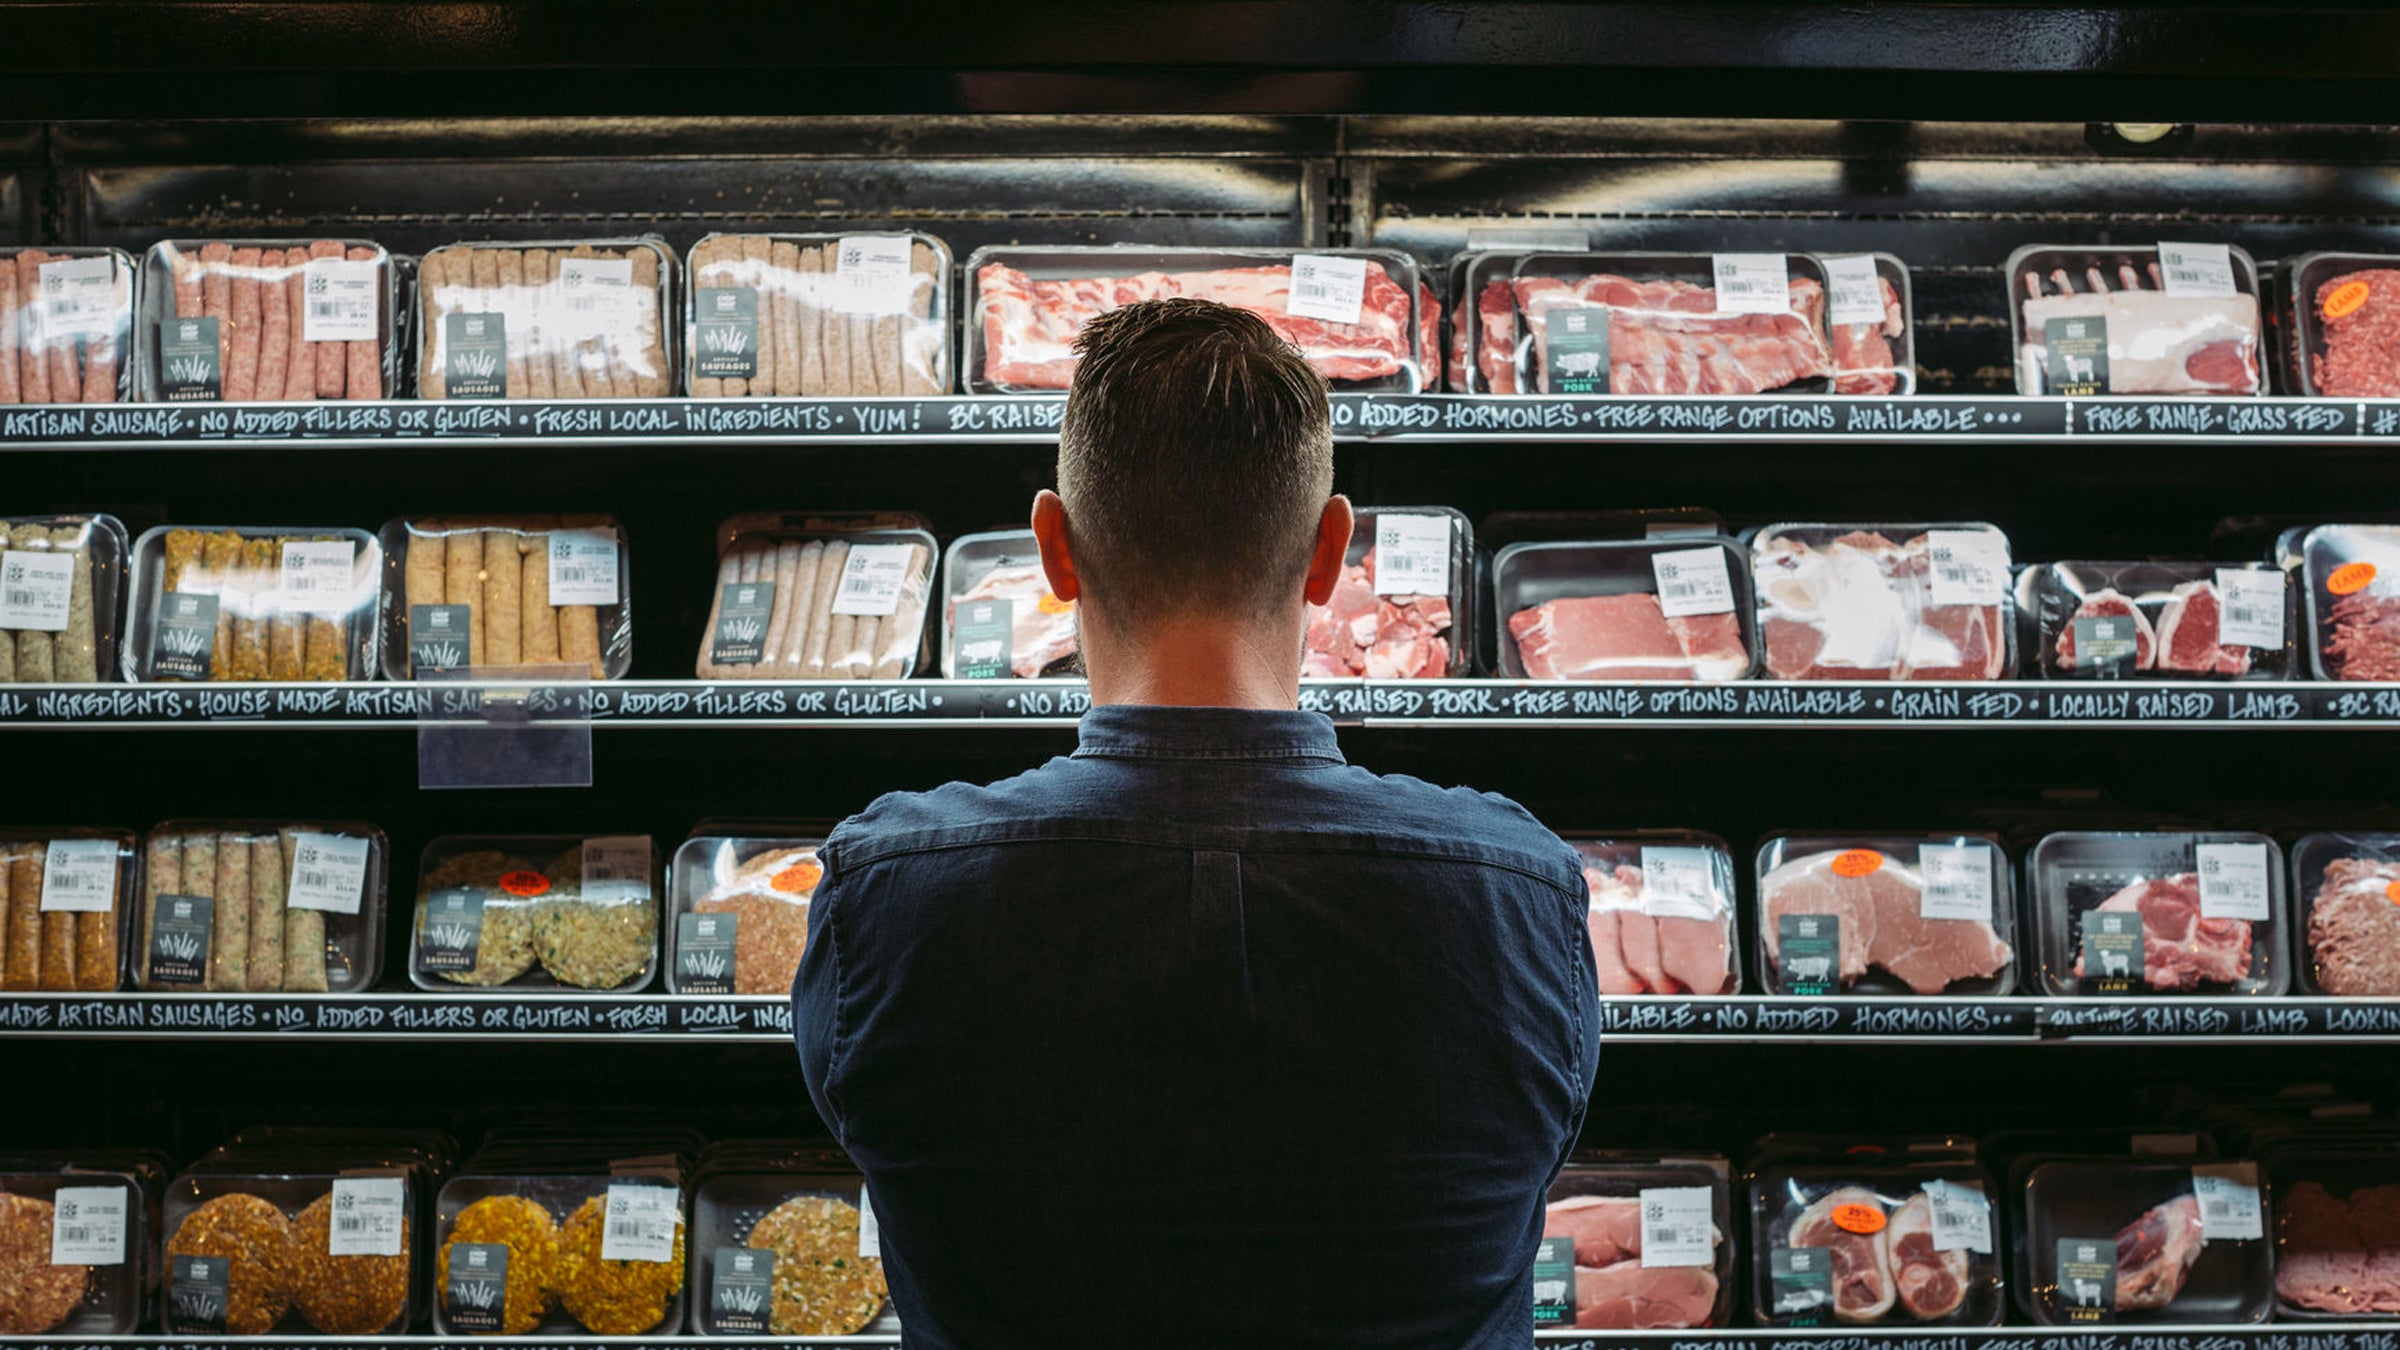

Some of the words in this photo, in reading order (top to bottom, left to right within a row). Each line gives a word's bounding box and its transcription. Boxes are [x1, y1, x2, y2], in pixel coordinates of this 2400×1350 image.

[2329, 285, 2364, 313] LAMB
[702, 362, 751, 371] SAUSAGES
[452, 386, 501, 394] SAUSAGES
[1563, 383, 1593, 392] PORK
[2064, 387, 2095, 396] LAMB
[169, 391, 216, 400] SAUSAGES
[4, 409, 86, 437] ARTISAN
[91, 408, 183, 437] SAUSAGE
[200, 410, 229, 432] NO
[234, 409, 300, 434] ADDED
[301, 406, 393, 432] FILLERS
[398, 408, 429, 430] OR
[434, 405, 512, 431] GLUTEN
[533, 405, 603, 435] FRESH
[610, 408, 680, 432] LOCAL
[685, 403, 832, 433] INGREDIENTS
[948, 404, 985, 432] BC
[986, 403, 1067, 430] RAISE
[1359, 402, 1440, 428] ADDED
[1443, 402, 1579, 430] HORMONES
[1593, 403, 1656, 429] FREE
[1658, 403, 1734, 431] RANGE
[1738, 403, 1836, 430] OPTIONS
[1847, 403, 1978, 432] AVAILABLE
[2084, 404, 2144, 432] FREE
[2147, 403, 2216, 431] RANGE
[2227, 404, 2287, 432] GRASS
[2288, 404, 2345, 431] FED
[2334, 567, 2371, 590] LAMB
[715, 648, 759, 659] SAUSAGES
[156, 660, 204, 673] SAUSAGES
[969, 667, 996, 679] PORK
[37, 689, 183, 720] INGREDIENTS
[200, 690, 271, 717] HOUSE
[277, 688, 340, 715] MADE
[346, 687, 433, 717] ARTISAN
[443, 689, 558, 714] SAUES
[578, 689, 610, 711] NO
[620, 689, 689, 715] ADDED
[692, 686, 787, 715] FILLERS
[796, 690, 826, 715] OR
[834, 687, 927, 715] GLUTEN
[1019, 690, 1053, 716] NO
[1299, 689, 1333, 714] BC
[1334, 685, 1424, 716] RAISED
[1428, 688, 1501, 716] PORK
[1512, 689, 1569, 716] FREE
[1573, 689, 1645, 718] RANGE
[1650, 687, 1740, 715] OPTIONS
[1745, 687, 1867, 716] AVAILABLE
[1890, 688, 1961, 720] GRAIN
[1966, 692, 2023, 719] FED
[2050, 691, 2131, 720] LOCALLY
[2135, 688, 2215, 719] RAISED
[2228, 691, 2301, 720] LAMB
[2339, 691, 2372, 716] BC
[426, 957, 471, 965] SAUSAGES
[154, 966, 200, 977] SAUSAGES
[681, 986, 729, 994] SAUSAGES
[1794, 987, 1823, 995] PORK
[2099, 982, 2129, 992] LAMB
[58, 1003, 145, 1028] ARTISAN
[150, 1003, 257, 1030] SAUSAGES
[275, 1006, 306, 1028] NO
[317, 1005, 385, 1028] ADDED
[389, 1005, 475, 1029] FILLERS
[482, 1006, 511, 1028] OR
[513, 1005, 591, 1029] GLUTEN
[607, 1004, 668, 1031] FRESH
[681, 1004, 748, 1027] LOCAL
[753, 1005, 793, 1031] ING
[1600, 1002, 1698, 1031] ILABLE
[1716, 1004, 1749, 1030] NO
[1755, 1004, 1840, 1032] ADDED
[1850, 1005, 1990, 1034] HORMONES
[2142, 1006, 2231, 1034] RAISED
[2241, 1006, 2310, 1034] LAMB
[452, 1315, 498, 1325] SAUSAGES
[2071, 1311, 2101, 1321] LAMB
[716, 1320, 763, 1329] SAUSAGES
